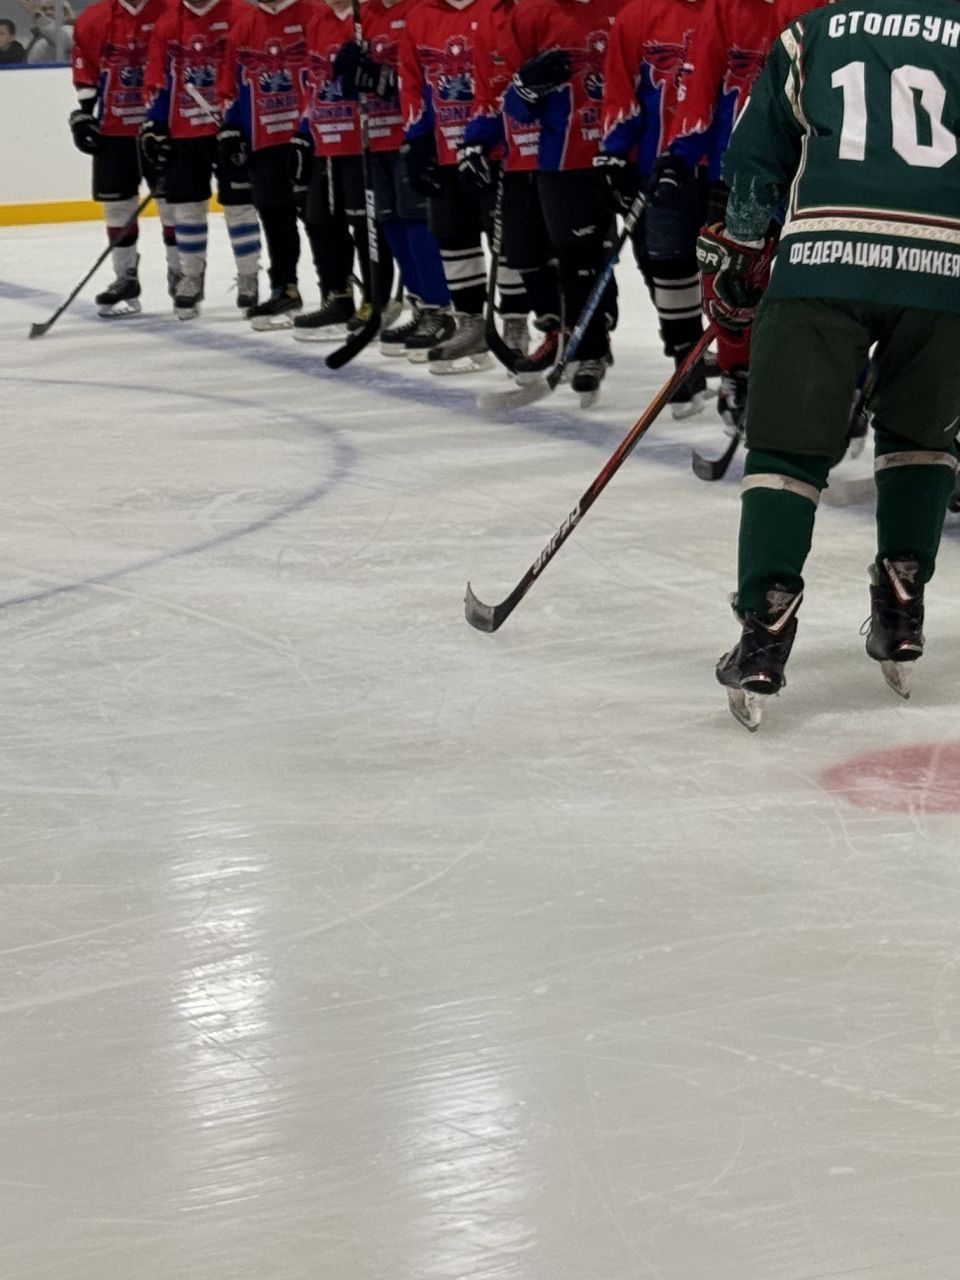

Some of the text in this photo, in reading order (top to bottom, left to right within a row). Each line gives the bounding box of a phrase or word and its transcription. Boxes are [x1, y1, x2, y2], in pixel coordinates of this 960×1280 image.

[828, 11, 960, 48] СТОЛБУН
[831, 61, 958, 168] 10
[790, 240, 894, 269] ФЕДЕРАЦИЯ
[896, 246, 960, 278] ХОККЕЯ
